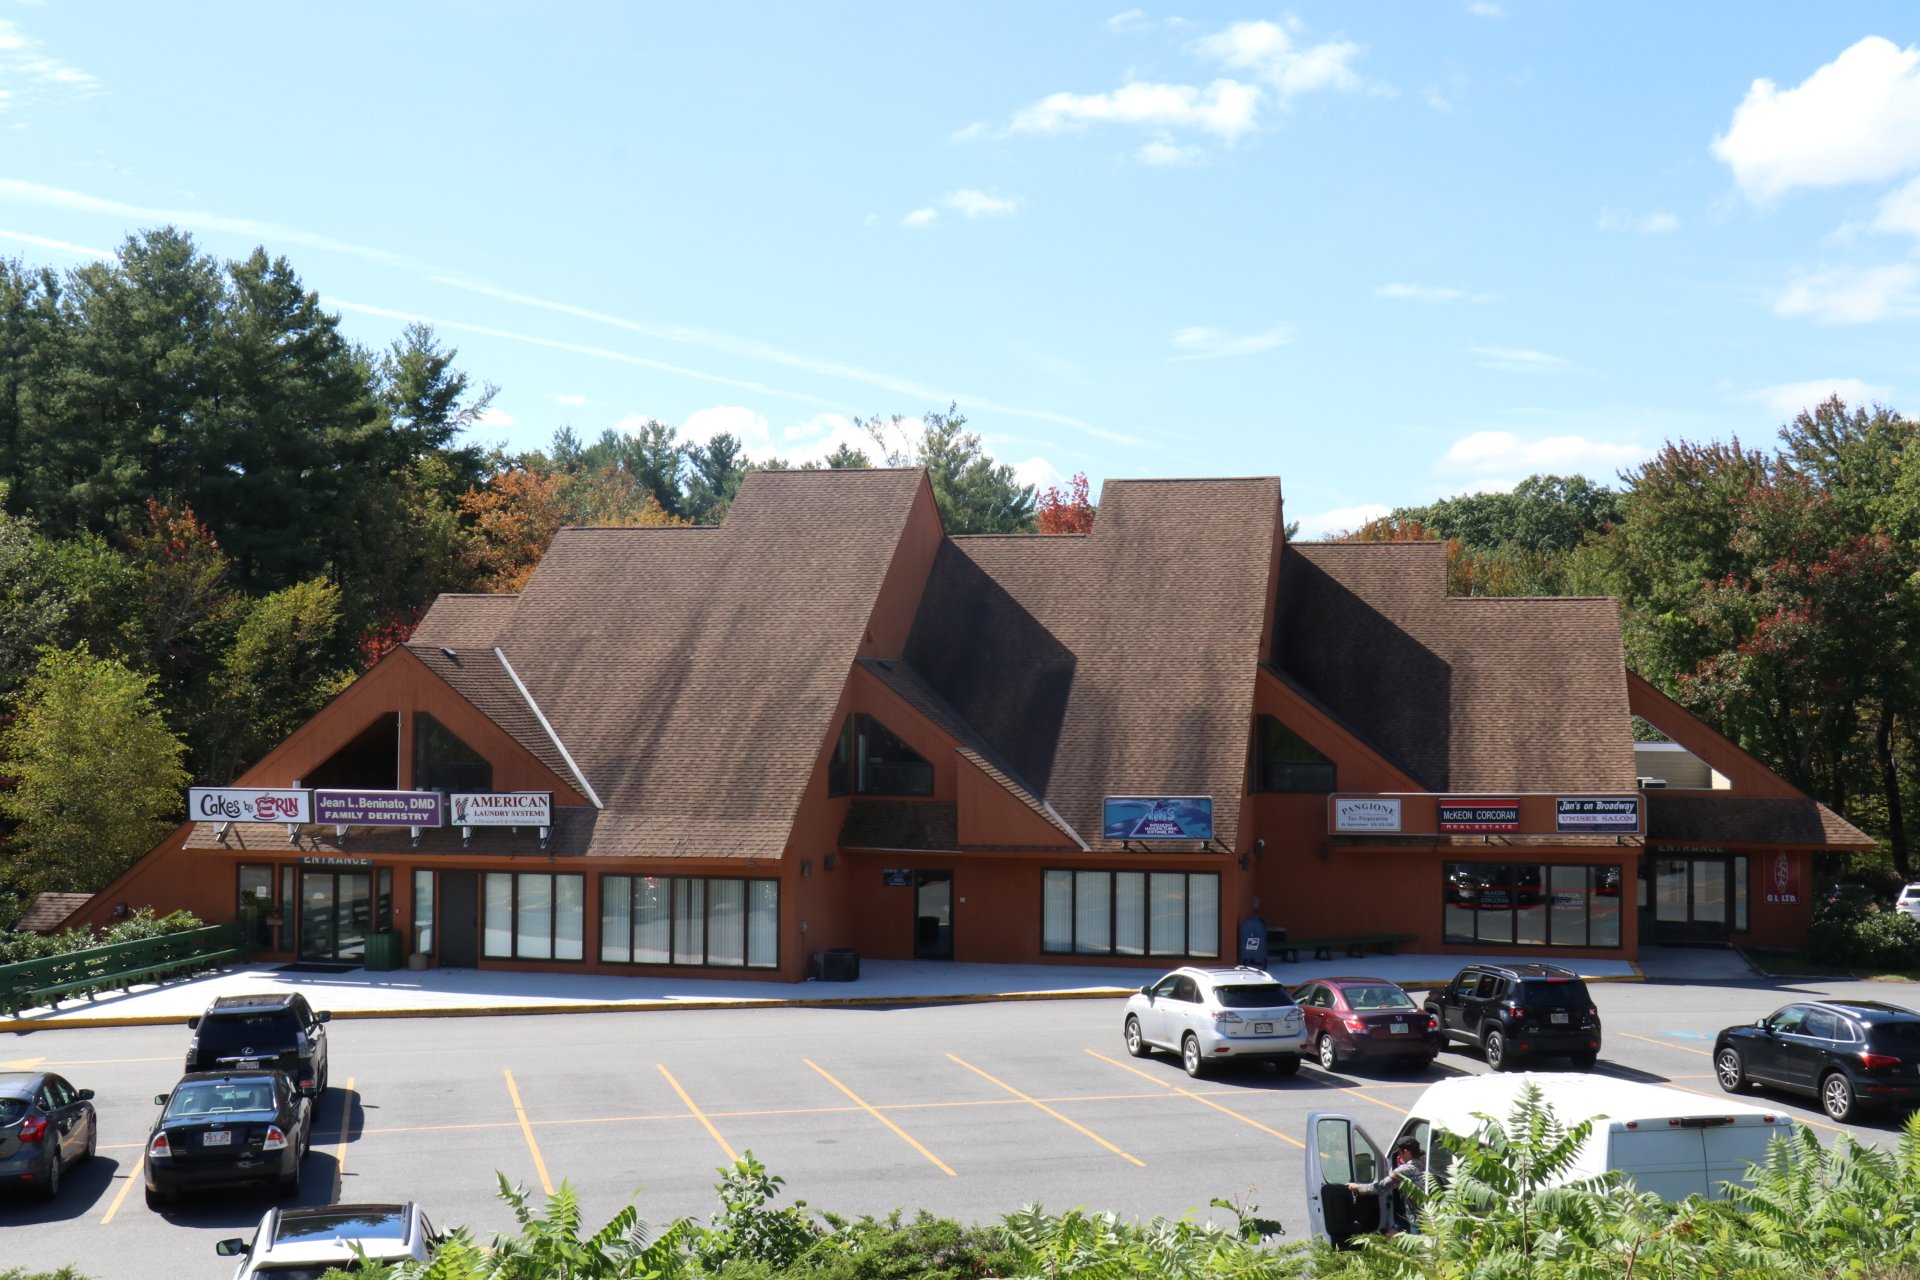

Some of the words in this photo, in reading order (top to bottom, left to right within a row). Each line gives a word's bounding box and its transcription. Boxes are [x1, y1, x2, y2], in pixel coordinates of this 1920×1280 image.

[200, 794, 242, 818] Cakes
[243, 801, 253, 813] by
[320, 797, 345, 808] Jean
[359, 798, 408, 811] Beninato,
[410, 799, 435, 809] DMD
[471, 796, 548, 808] AMERICAN
[1560, 801, 1581, 811] Jan's
[1596, 801, 1635, 814] Broadway
[1341, 803, 1395, 815] PANGIONE
[368, 812, 429, 820] DENTISTRY
[1443, 811, 1473, 820] McKEON
[1476, 811, 1516, 820] CORCORAN
